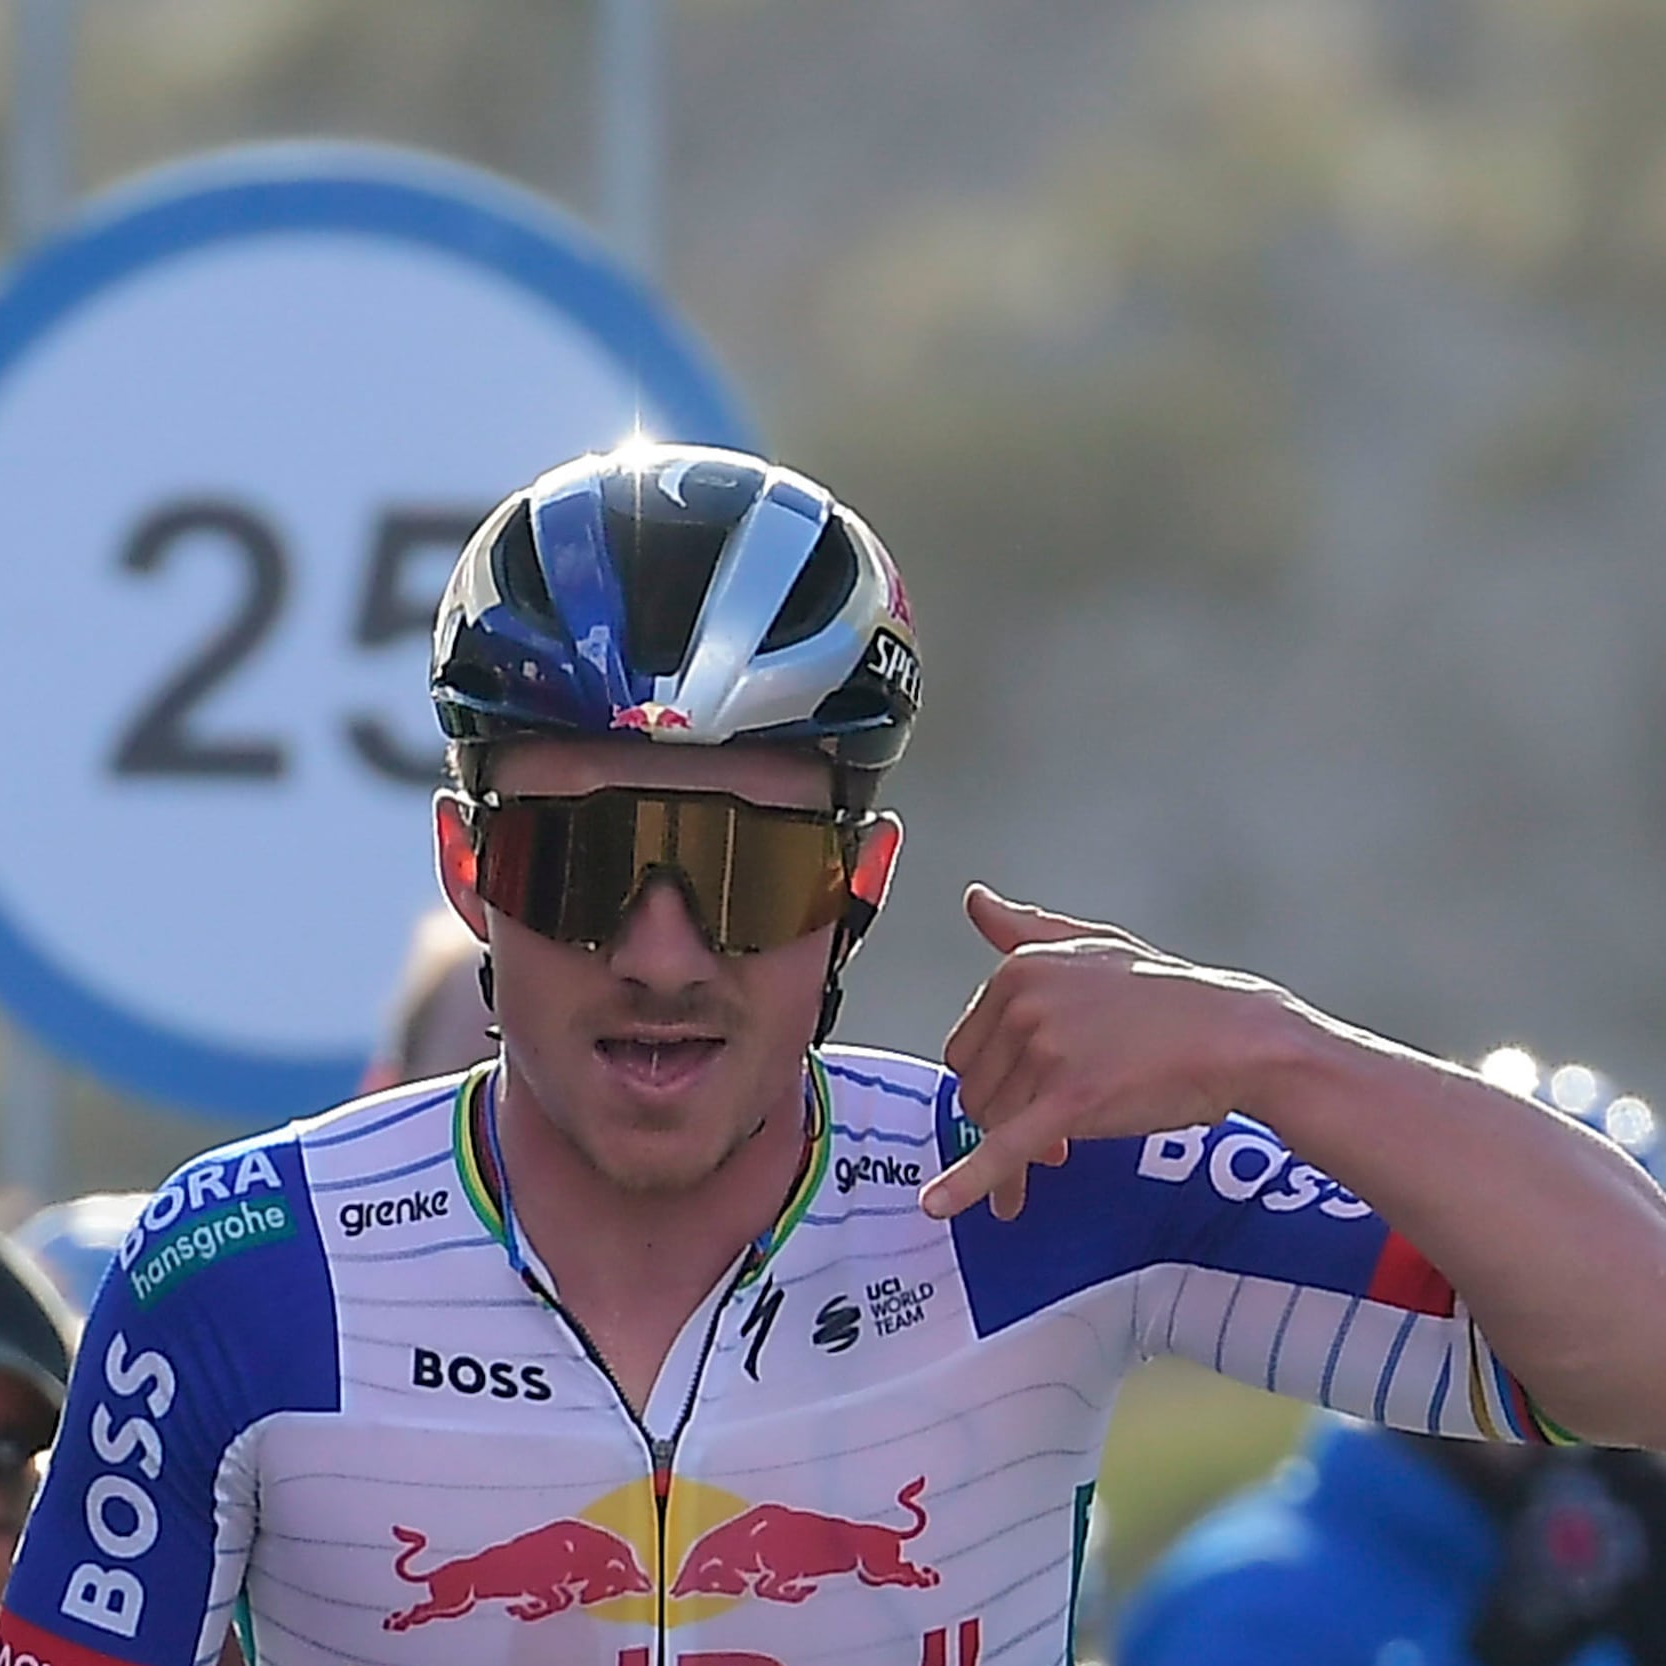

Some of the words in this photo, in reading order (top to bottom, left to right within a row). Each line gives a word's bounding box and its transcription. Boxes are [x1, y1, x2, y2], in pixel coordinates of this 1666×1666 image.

[108, 488, 478, 788] 25
[119, 1149, 283, 1272] BORA
[339, 1189, 450, 1237] grenke
[130, 1200, 286, 1300] hansgrohe
[865, 1276, 903, 1301] UCI
[870, 1281, 934, 1321] WORLD
[873, 1305, 926, 1338] TEAM
[411, 1347, 553, 1402] BOSS
[60, 1331, 176, 1640] BOSS
